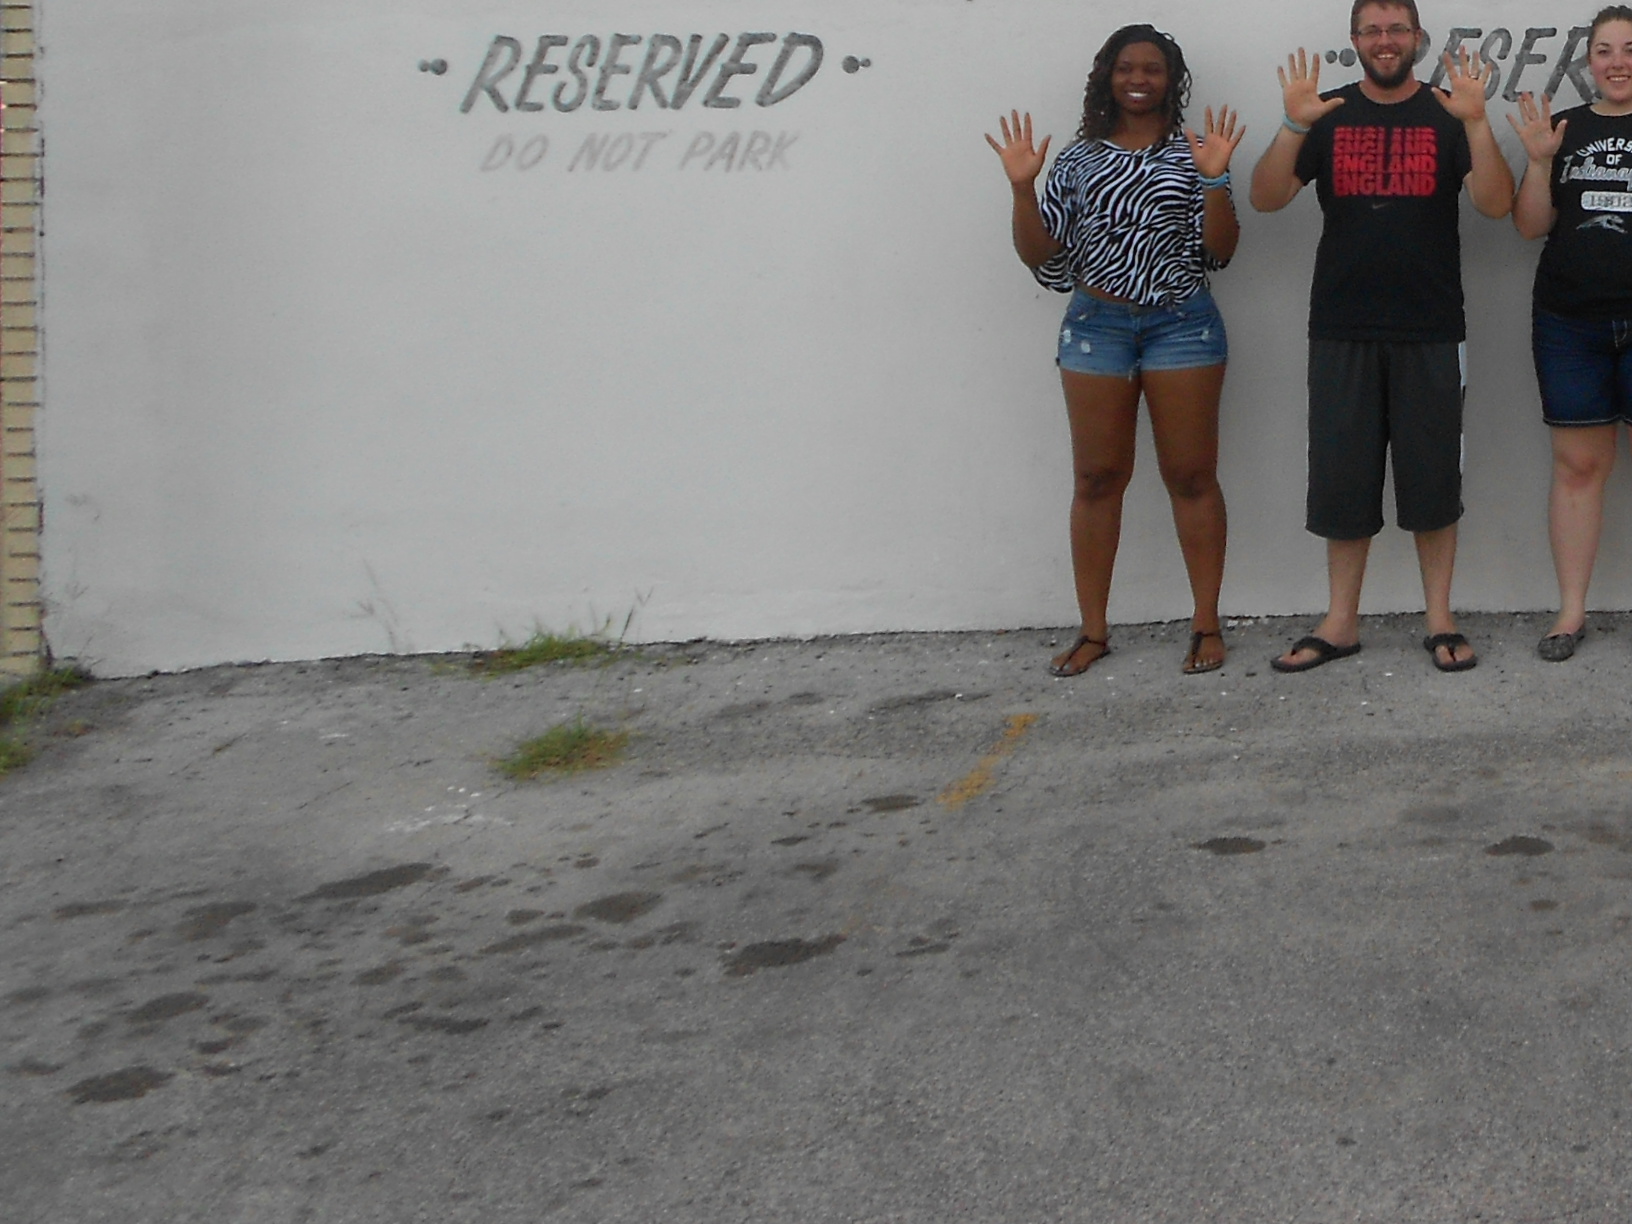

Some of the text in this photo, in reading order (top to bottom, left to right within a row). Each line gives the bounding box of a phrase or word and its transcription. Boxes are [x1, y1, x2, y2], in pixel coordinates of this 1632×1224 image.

[460, 31, 825, 114] RESERVED
[479, 129, 800, 173] DO NOT PARK
[1605, 153, 1624, 166] OF
[1333, 173, 1438, 197] ENGLAND
